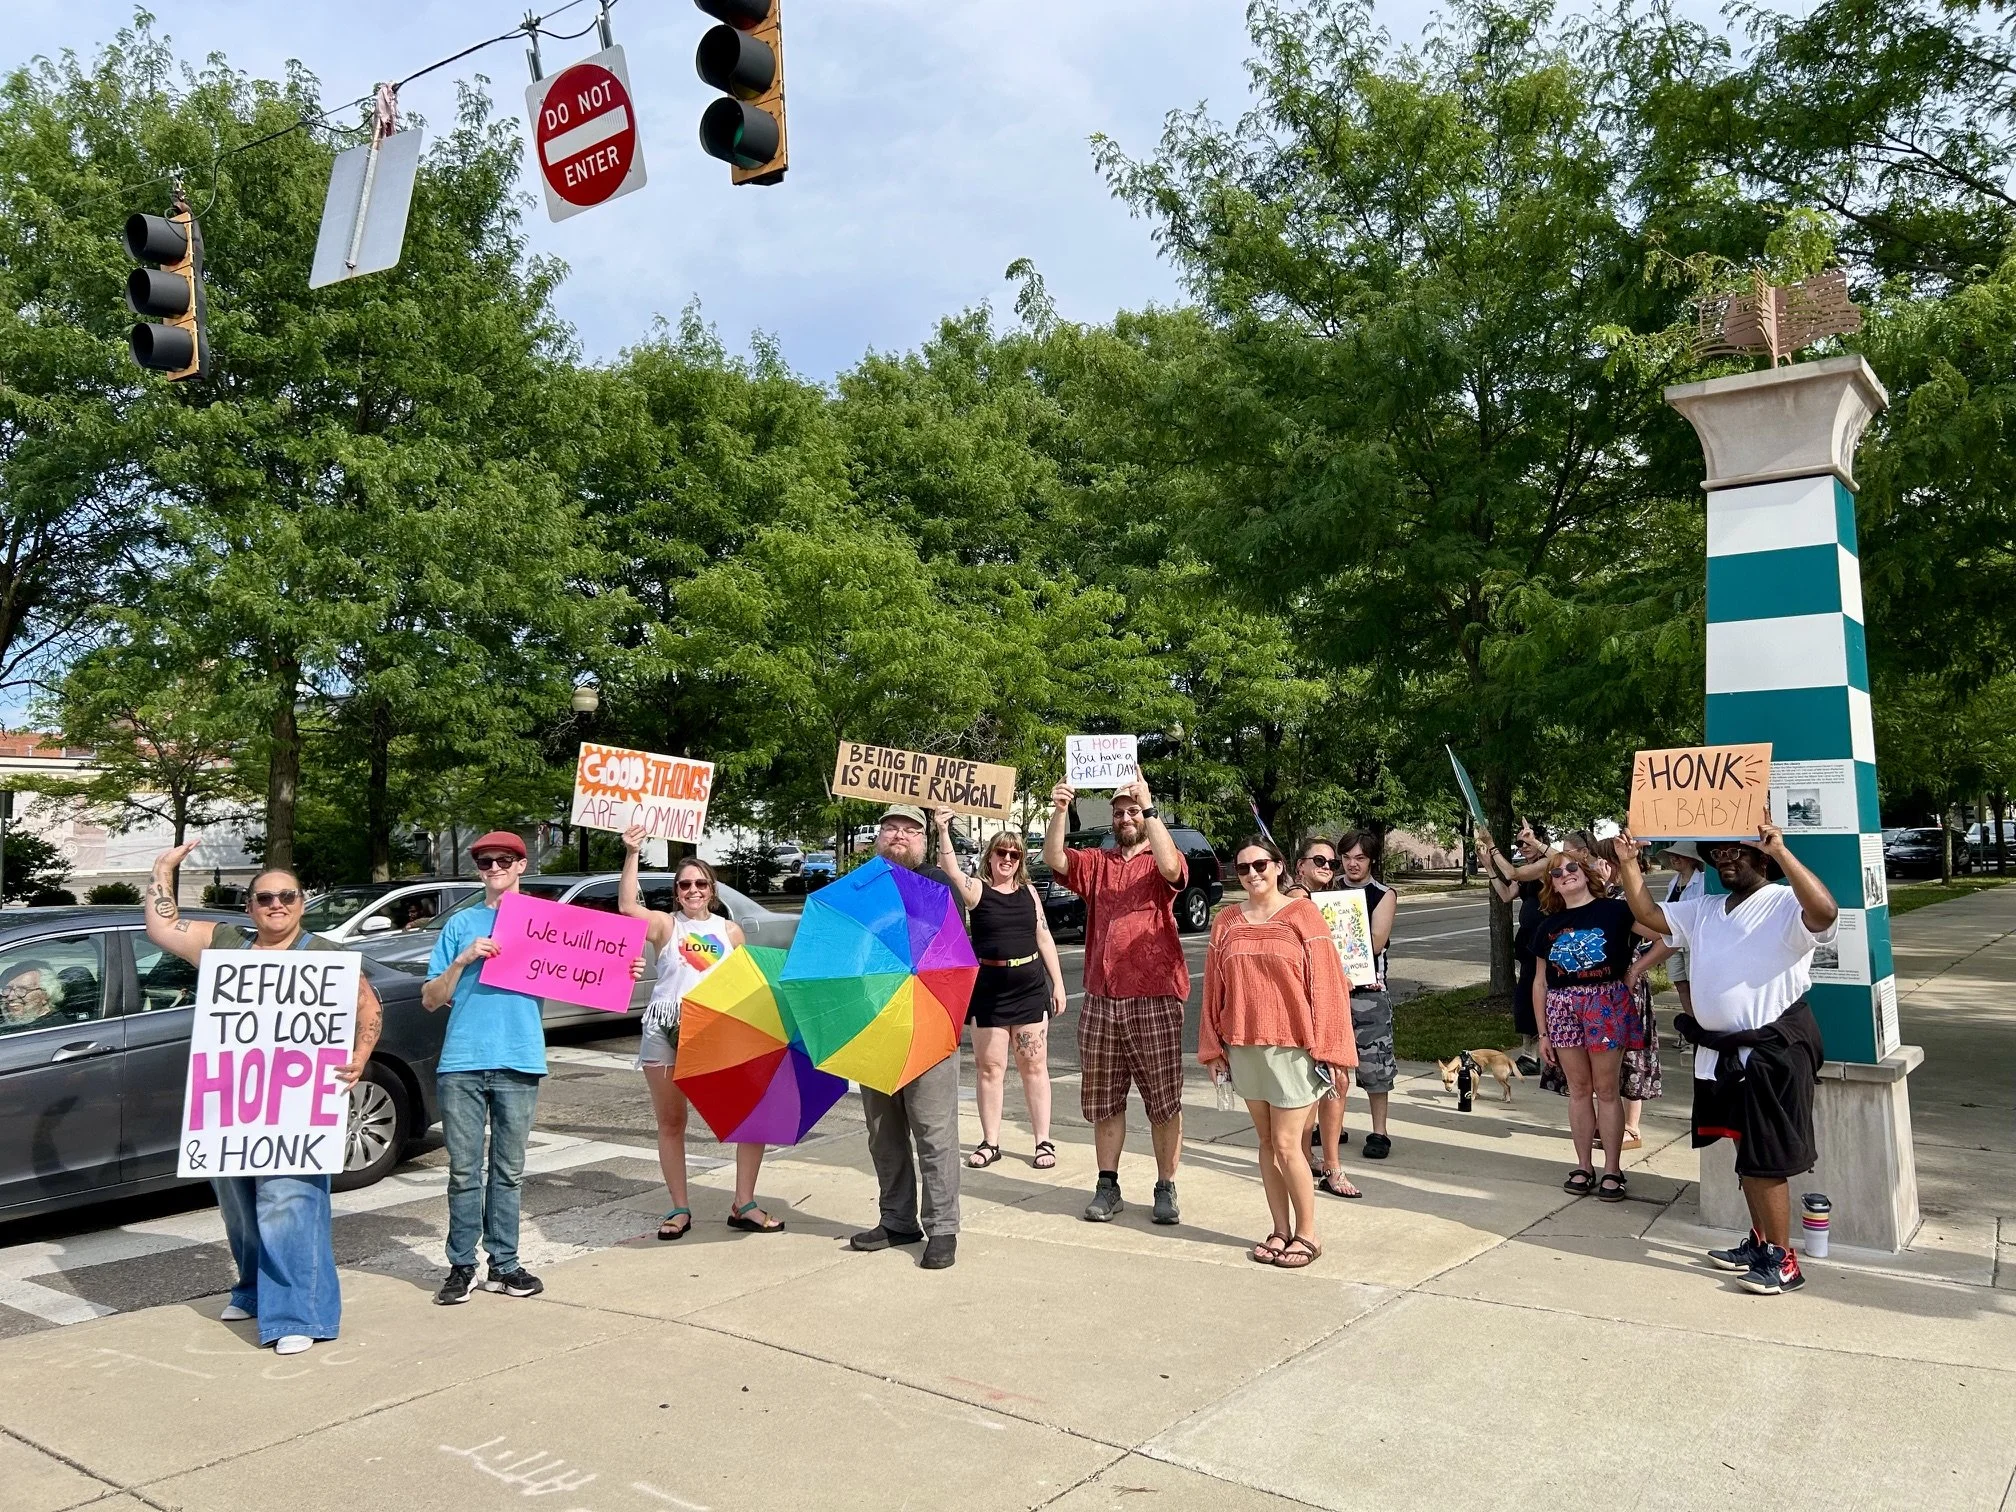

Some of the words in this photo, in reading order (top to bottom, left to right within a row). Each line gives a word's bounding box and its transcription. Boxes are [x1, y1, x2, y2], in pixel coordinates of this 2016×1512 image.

[545, 103, 569, 130] DO
[577, 80, 611, 114] NOT
[564, 145, 620, 187] ENTER
[1073, 740, 1082, 752] I
[1092, 738, 1128, 751] HOPE
[1100, 752, 1122, 762] have
[1124, 753, 1134, 761] a
[583, 753, 646, 791] GOOD
[650, 760, 710, 802] THINGS
[841, 764, 864, 787] IS
[868, 768, 921, 796] QUITE
[927, 776, 1003, 810] RADICAL
[935, 757, 978, 784] HOPE
[1071, 763, 1112, 780] GREAT
[1648, 752, 1744, 791] HONK
[577, 797, 623, 829] ARE
[631, 803, 702, 840] COMING!
[1676, 793, 1753, 831] BABY!
[526, 918, 558, 943] We
[563, 929, 594, 951] will
[594, 937, 628, 958] not
[685, 943, 717, 954] LOVE
[212, 963, 345, 1007] REFUSE
[526, 958, 567, 980] give
[572, 967, 605, 990] up!
[1350, 962, 1369, 970] WORLD
[209, 1010, 259, 1044] TO
[274, 1010, 348, 1046] LOSE
[188, 1046, 348, 1131] HOPE
[186, 1139, 207, 1170] &
[218, 1133, 326, 1172] HONK
